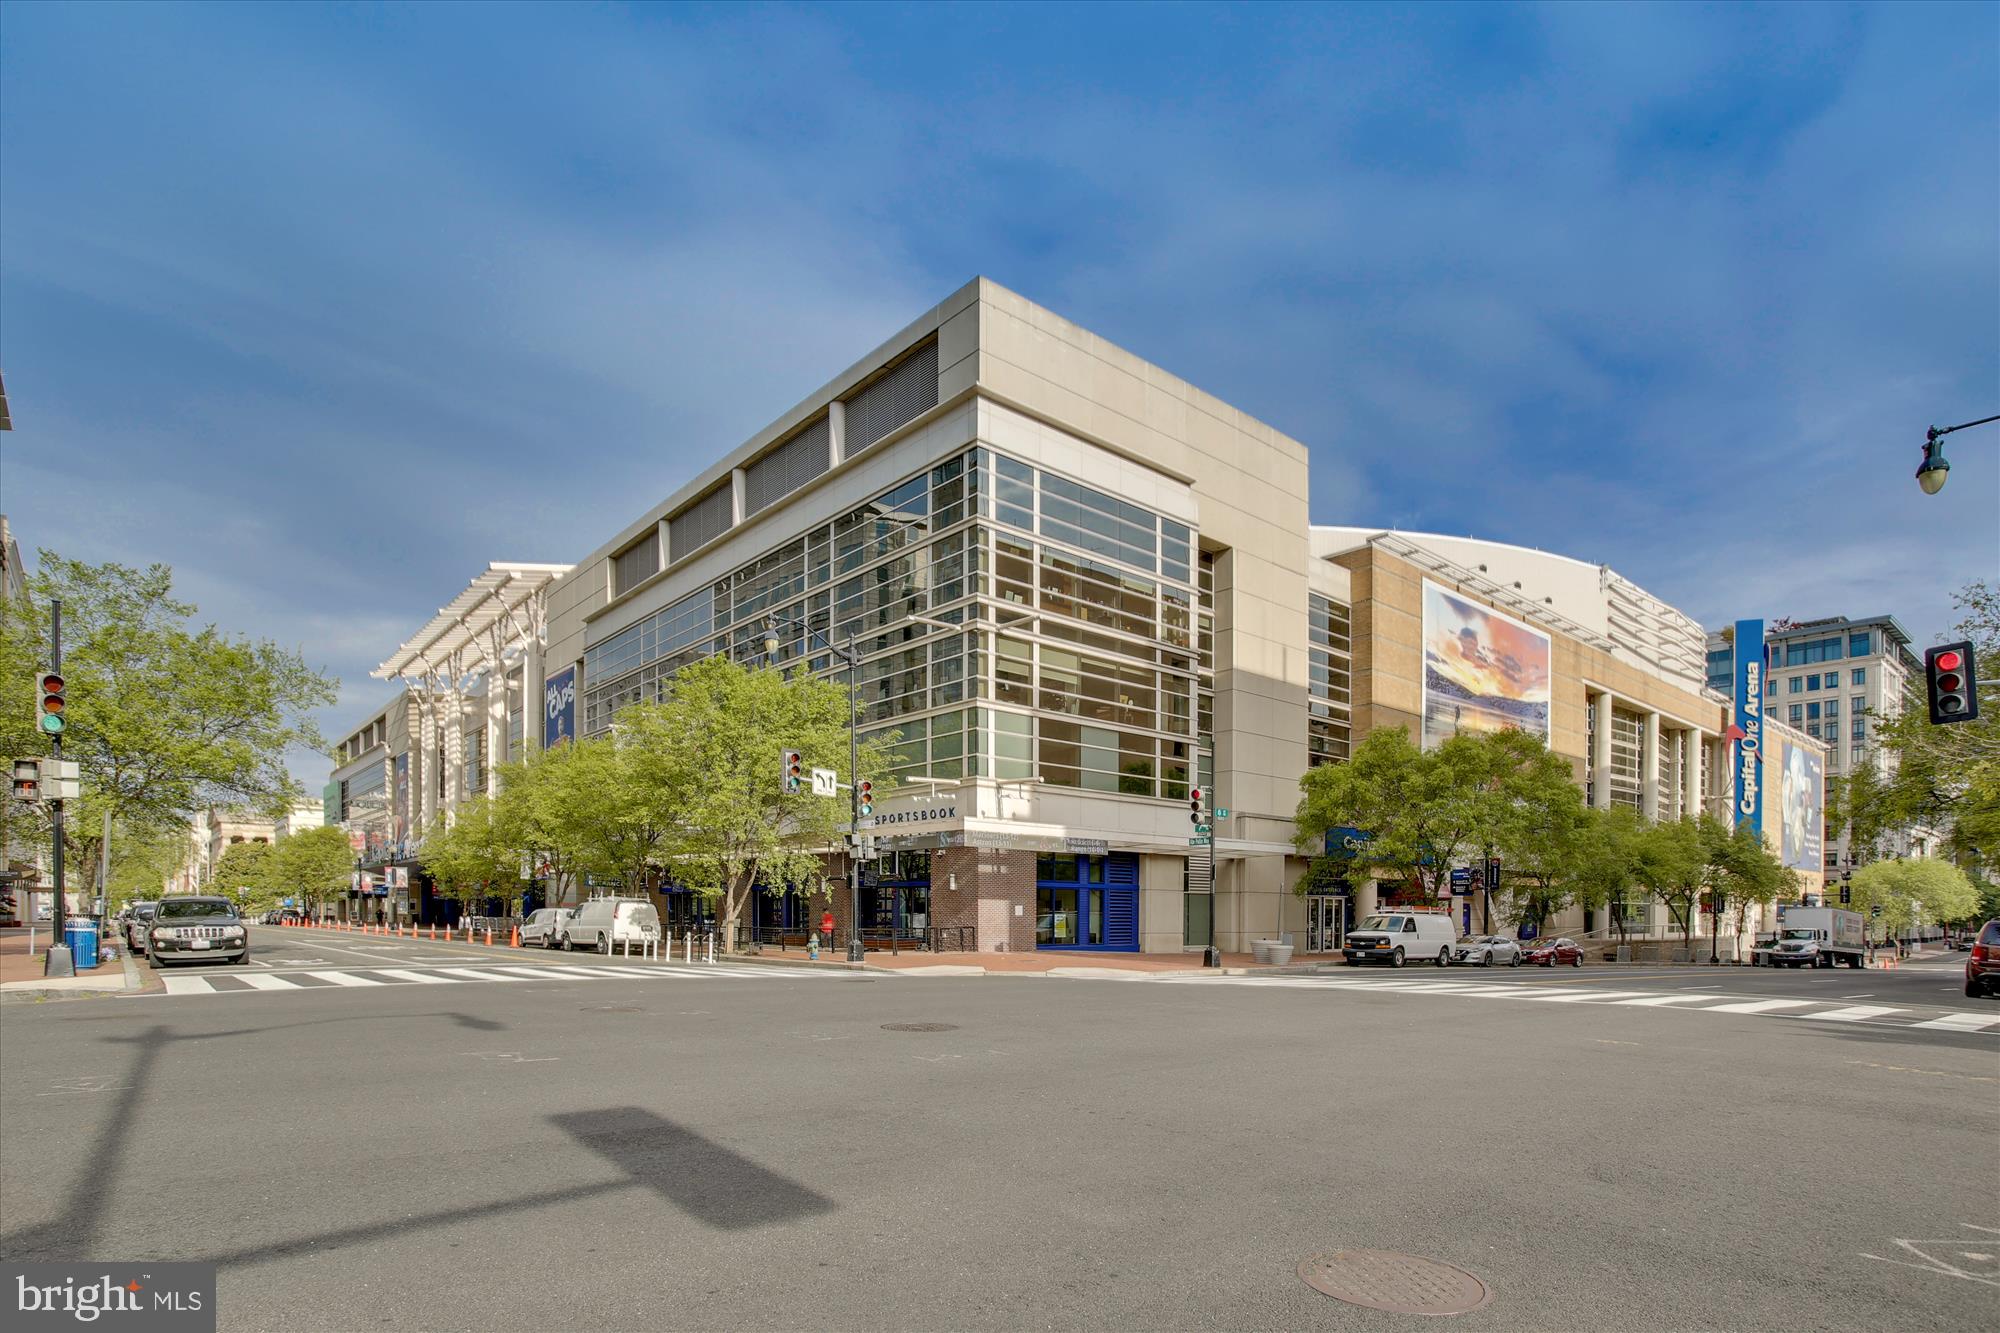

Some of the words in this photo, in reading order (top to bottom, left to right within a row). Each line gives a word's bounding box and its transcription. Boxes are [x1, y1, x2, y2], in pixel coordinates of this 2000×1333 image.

[547, 684, 558, 704] ALL
[549, 680, 574, 719] CAPS
[1744, 661, 1759, 717] Arena
[874, 806, 957, 825] SPORTSBOOK
